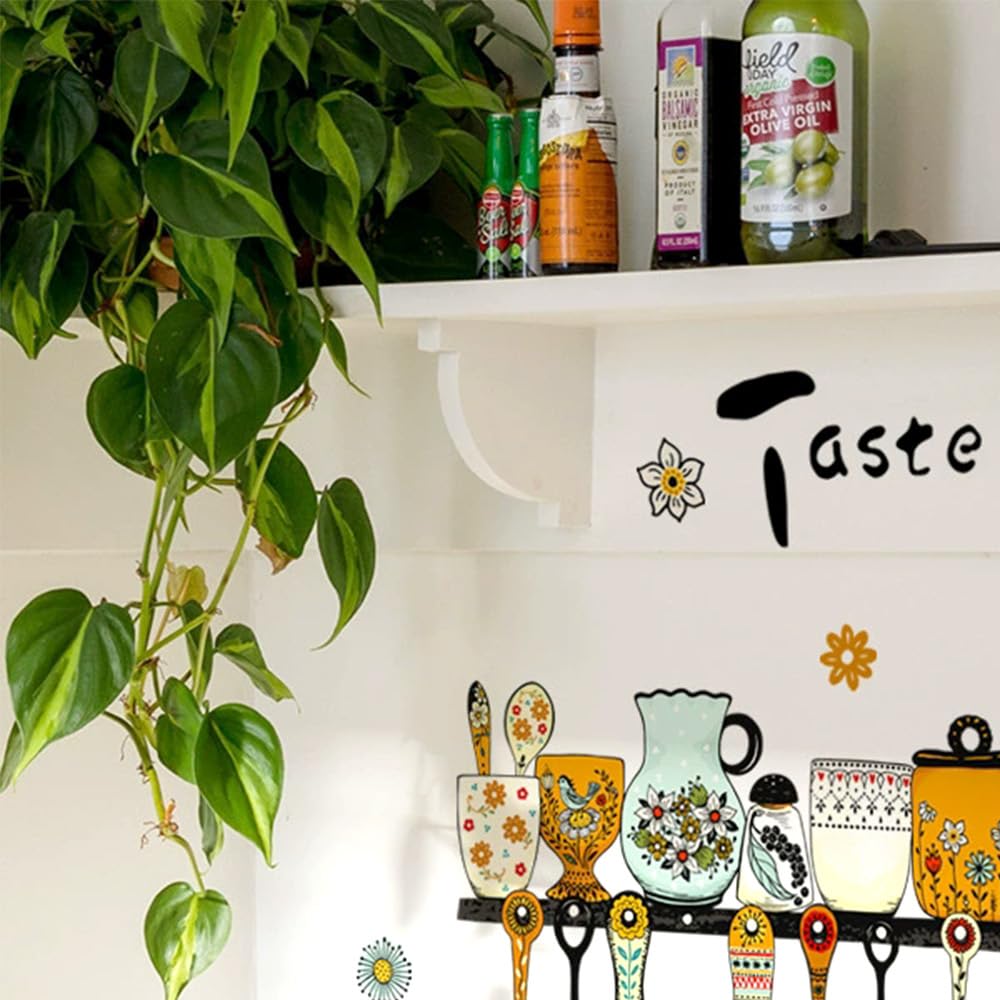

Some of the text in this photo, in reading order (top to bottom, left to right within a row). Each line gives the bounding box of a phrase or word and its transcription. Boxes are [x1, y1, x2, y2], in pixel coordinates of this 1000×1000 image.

[662, 88, 699, 98] ORGANIC
[781, 100, 832, 117] VIRGIN
[662, 119, 699, 130] VINEGAR
[750, 114, 820, 136] OLIVE OIL
[664, 181, 696, 189] PRODUCT
[664, 188, 696, 197] OF ITALY
[716, 371, 981, 548] Taste
